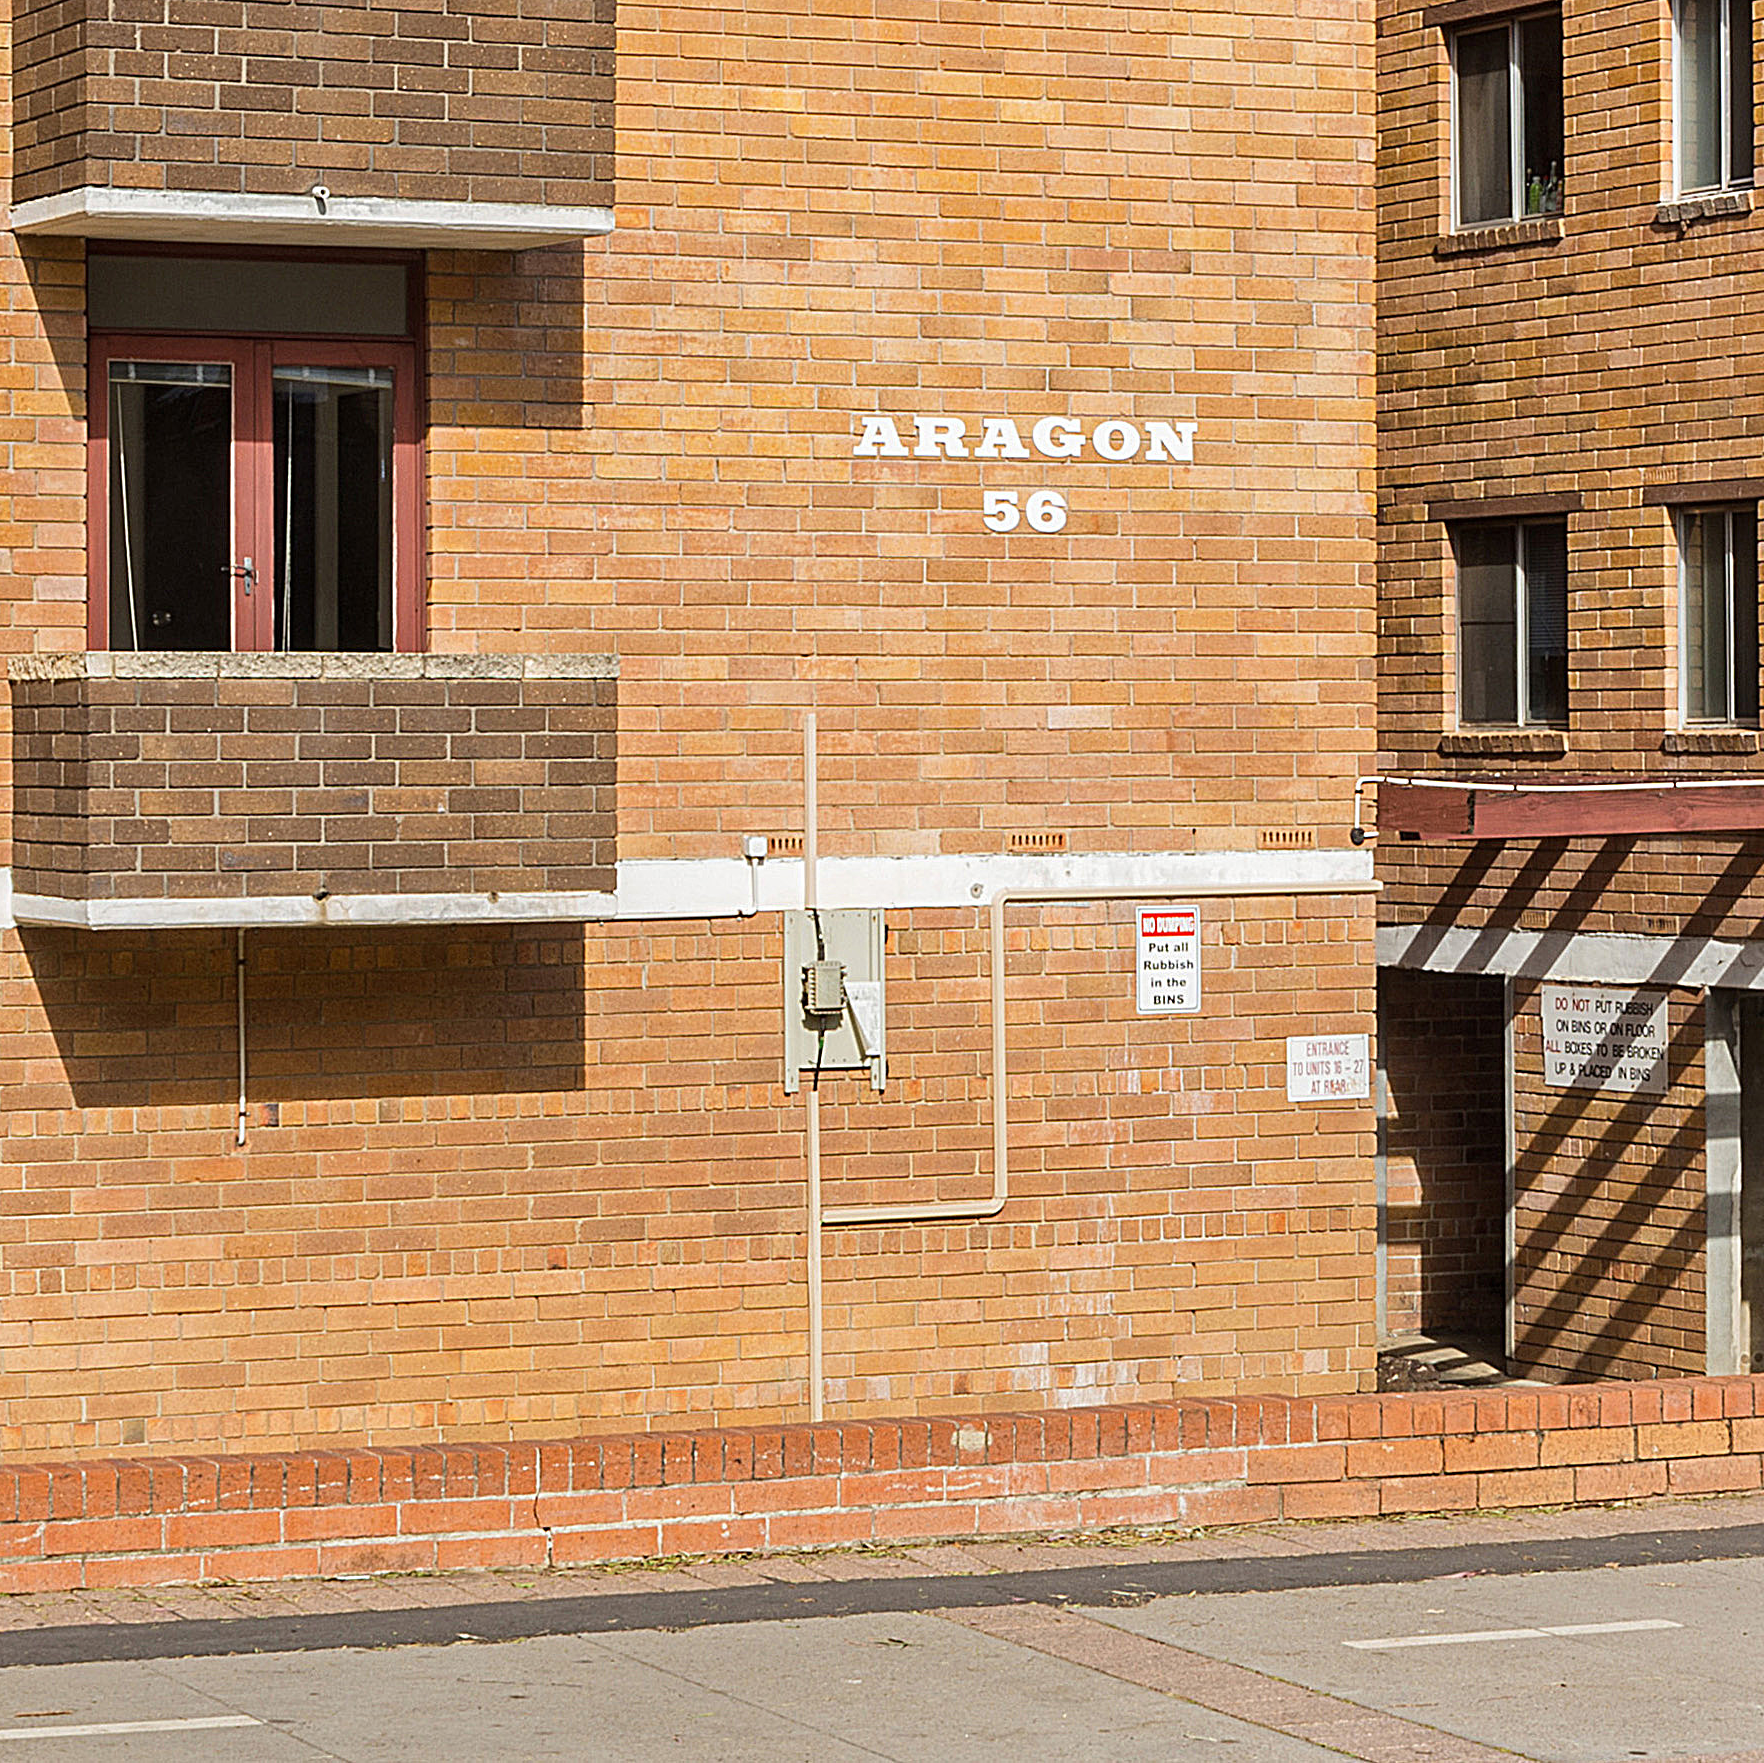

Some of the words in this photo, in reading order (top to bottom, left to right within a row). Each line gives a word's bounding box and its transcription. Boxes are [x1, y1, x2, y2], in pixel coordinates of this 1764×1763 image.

[853, 416, 1198, 462] ARAGON
[983, 490, 1068, 534] 56
[1143, 917, 1156, 933] NO
[1156, 917, 1194, 933] DUMPING
[1148, 943, 1169, 953] Put
[1173, 941, 1189, 953] all
[1143, 959, 1194, 970] Rubbish
[1150, 977, 1162, 988] in
[1166, 977, 1187, 988] the
[1153, 994, 1185, 1005] BINS
[1555, 997, 1568, 1011] DO
[1572, 998, 1590, 1012] NOT
[1595, 999, 1612, 1014] PUT
[1615, 1001, 1653, 1016] RUBBISH
[1556, 1019, 1569, 1033] ON
[1571, 1020, 1591, 1034] BINS
[1594, 1021, 1607, 1035] OR
[1610, 1022, 1624, 1037] ON
[1625, 1023, 1655, 1038] FLOOR
[1306, 1041, 1349, 1057] ENTRANCE
[1545, 1040, 1561, 1053] ALL
[1564, 1041, 1593, 1056] BOXES
[1596, 1043, 1608, 1058] TO
[1612, 1044, 1625, 1058] BE
[1626, 1045, 1665, 1060] BROKEN
[1292, 1062, 1303, 1076] TO
[1305, 1060, 1331, 1076] UNITS
[1353, 1058, 1364, 1074] 27
[1555, 1061, 1567, 1075] UP
[1569, 1062, 1576, 1076] &
[1578, 1063, 1612, 1078] PLACED
[1617, 1065, 1628, 1079] IN
[1629, 1067, 1652, 1082] BINS
[1311, 1080, 1321, 1095] AT
